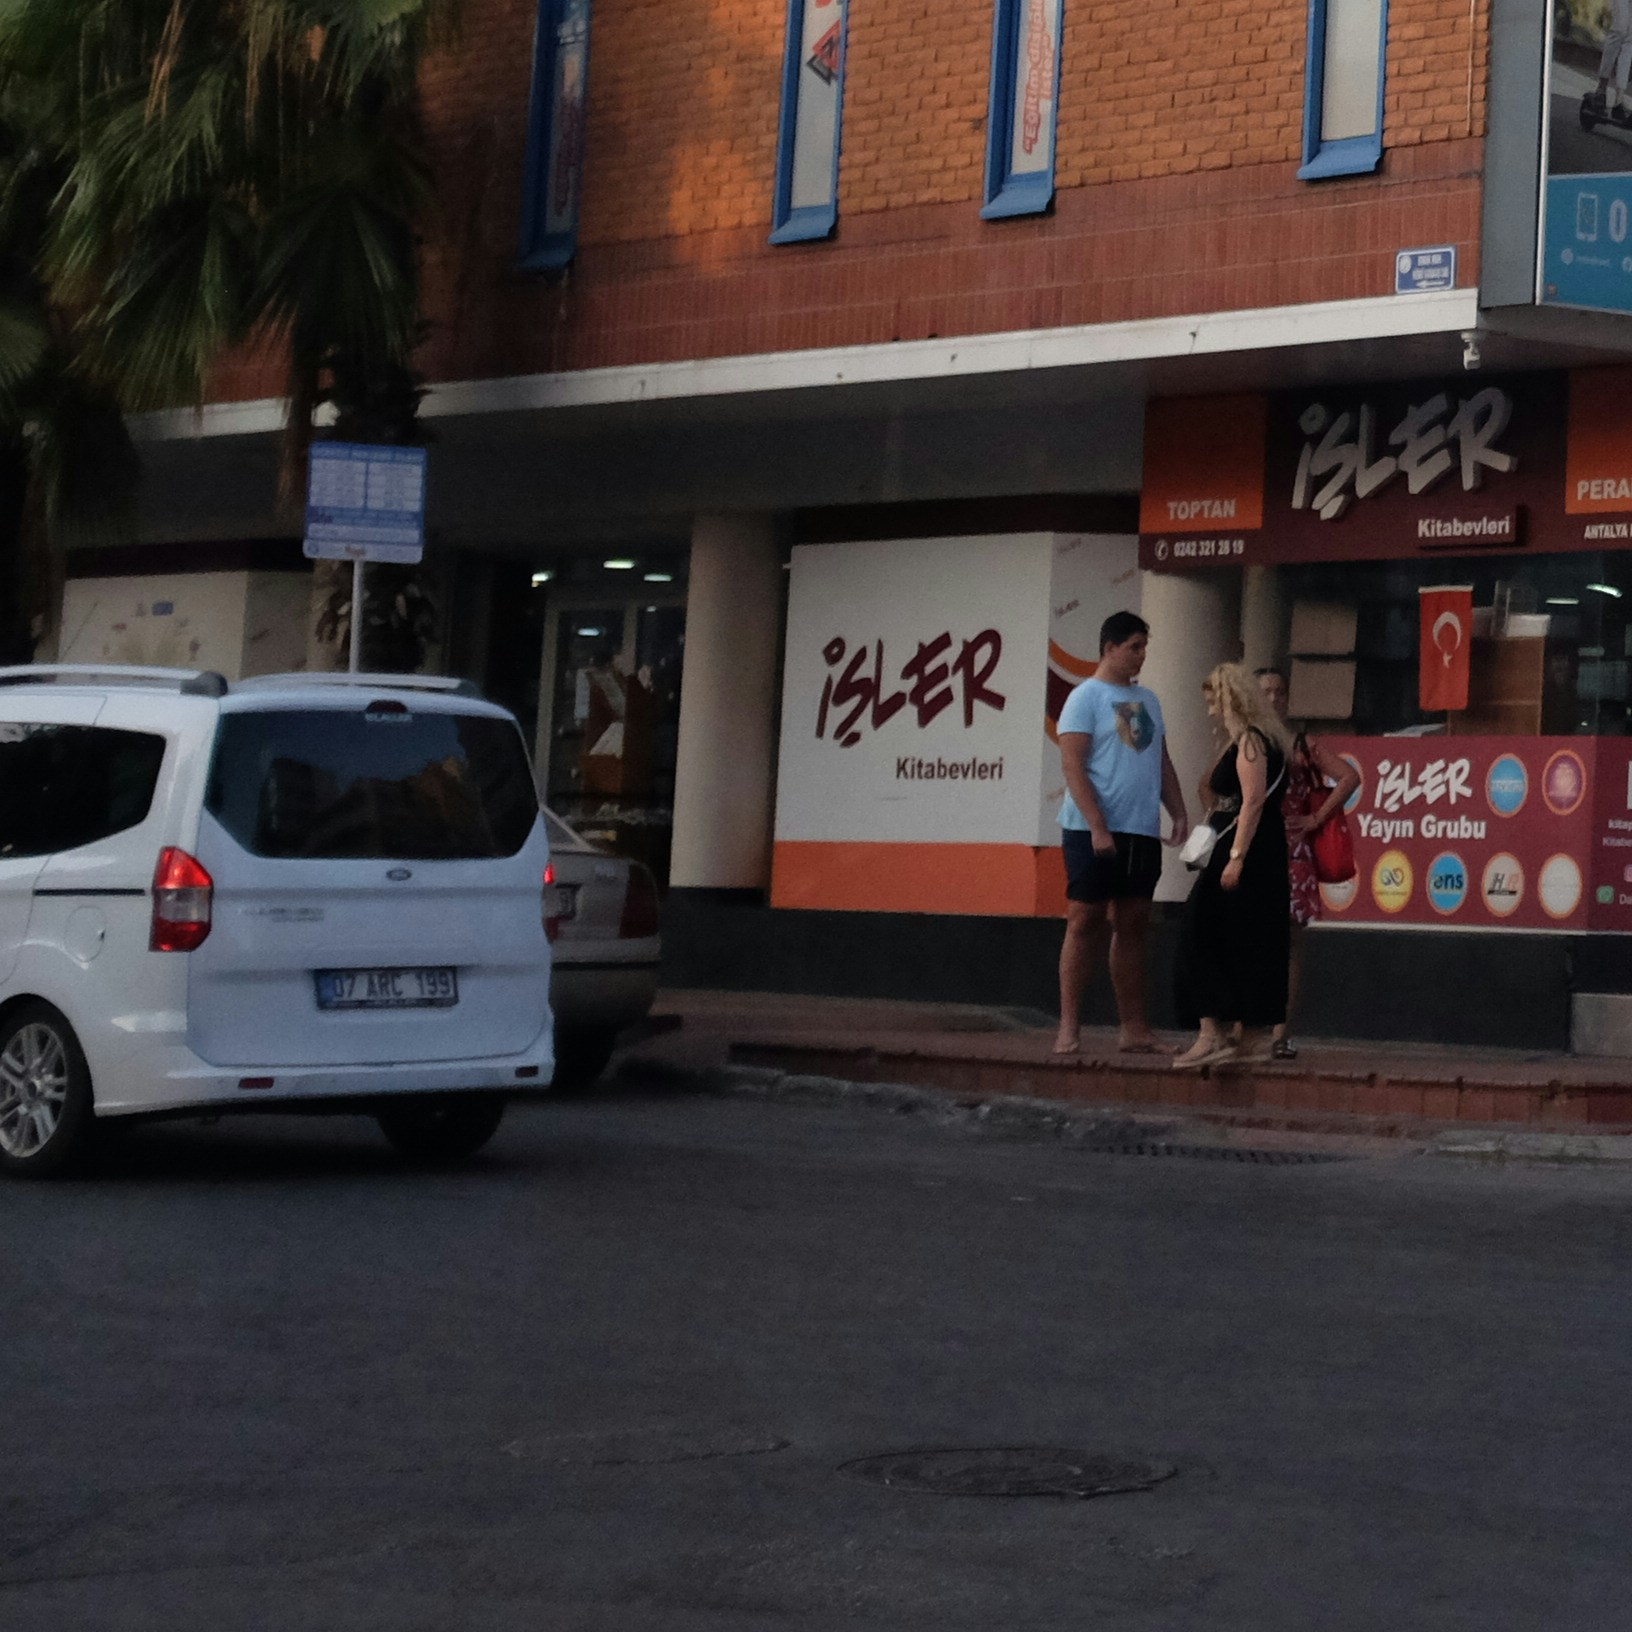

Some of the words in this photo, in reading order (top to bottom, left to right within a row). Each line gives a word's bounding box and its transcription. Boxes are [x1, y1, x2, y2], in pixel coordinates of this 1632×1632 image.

[1608, 198, 1628, 243] 0
[1166, 498, 1237, 520] TOPTAN
[1416, 514, 1511, 538] Kitabevleri
[1584, 523, 1628, 539] ANTALYA
[895, 756, 1004, 781] Kitabevleri
[1357, 813, 1414, 844] Yayın
[1420, 814, 1487, 840] Grubu
[334, 970, 355, 998] 07
[366, 970, 404, 998] ARC
[416, 970, 451, 997] 199
